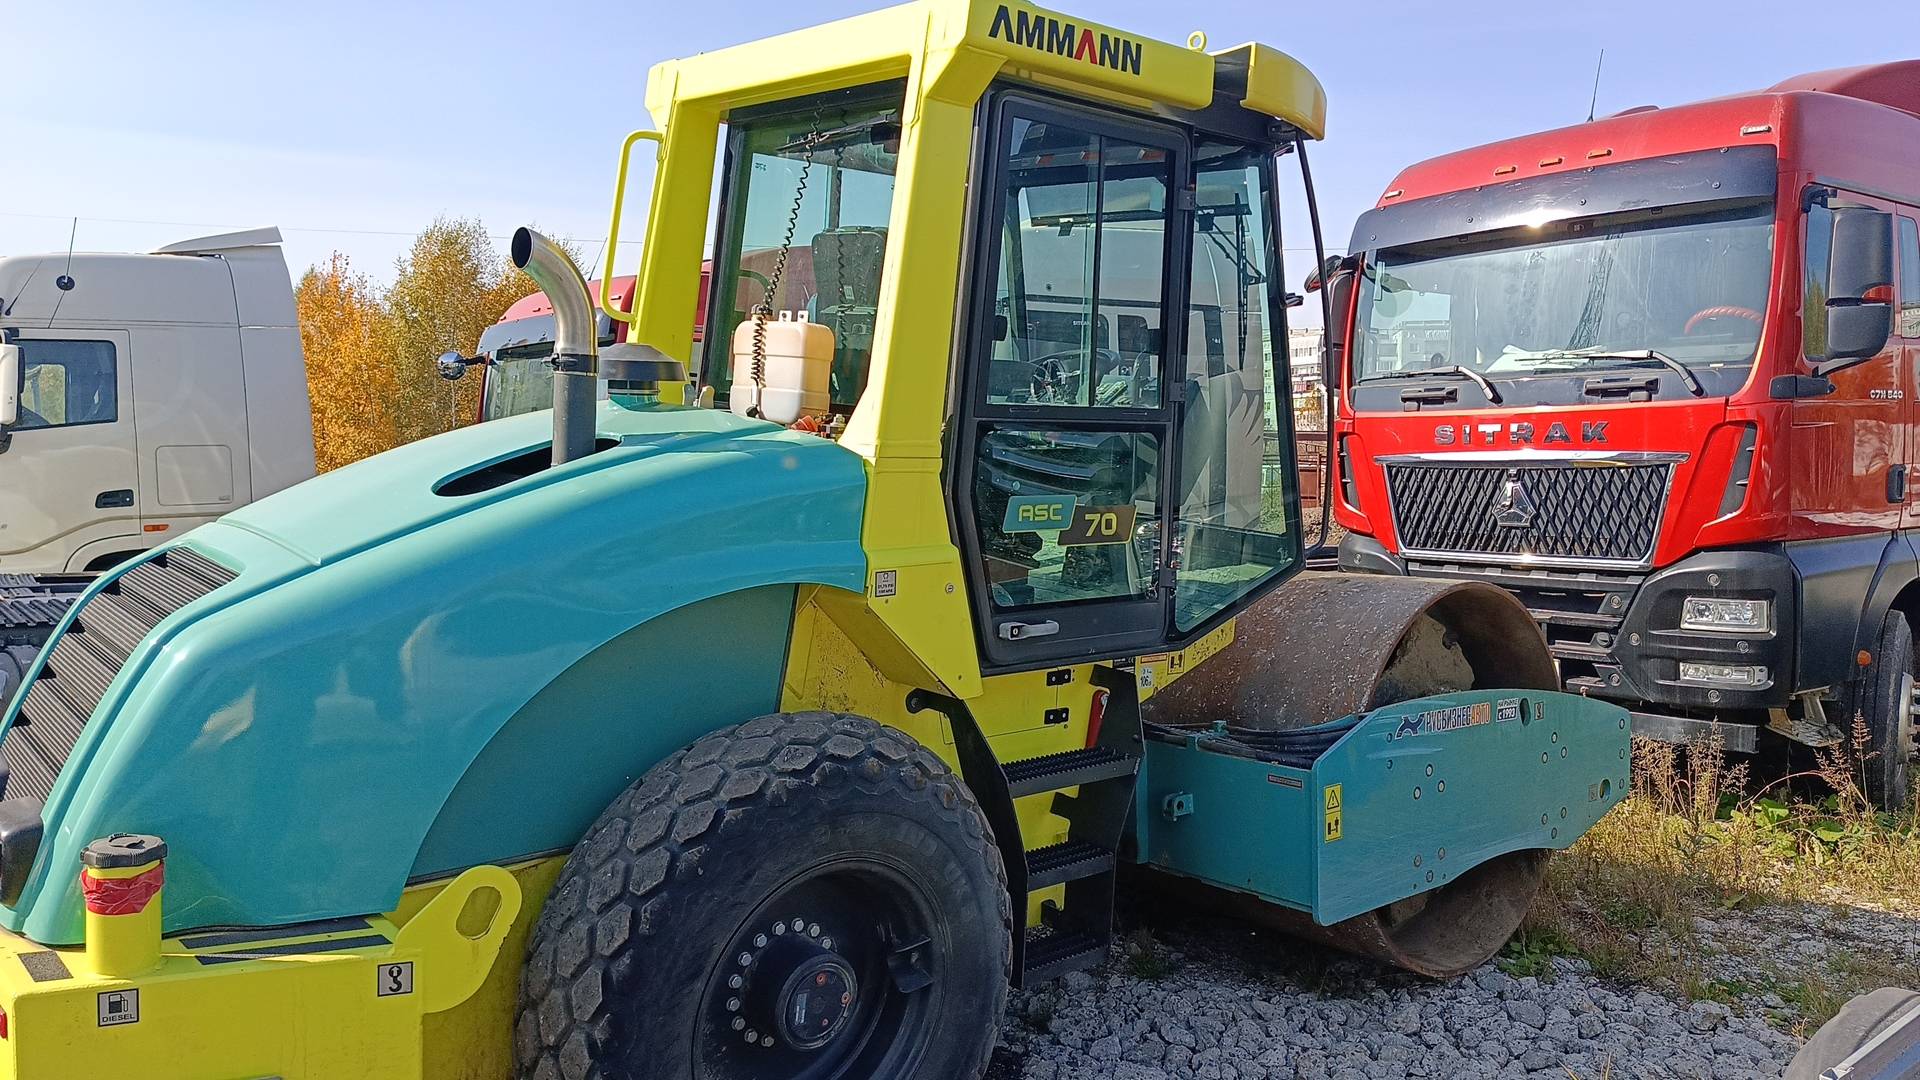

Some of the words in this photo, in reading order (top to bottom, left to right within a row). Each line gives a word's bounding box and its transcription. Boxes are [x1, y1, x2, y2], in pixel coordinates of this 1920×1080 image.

[988, 4, 1142, 76] AMMANN
[1434, 421, 1609, 445] SITRAK
[1018, 503, 1063, 522] ASC
[1085, 512, 1118, 537] 70
[1502, 707, 1516, 719] 1993
[102, 1014, 135, 1022] DIESEL
